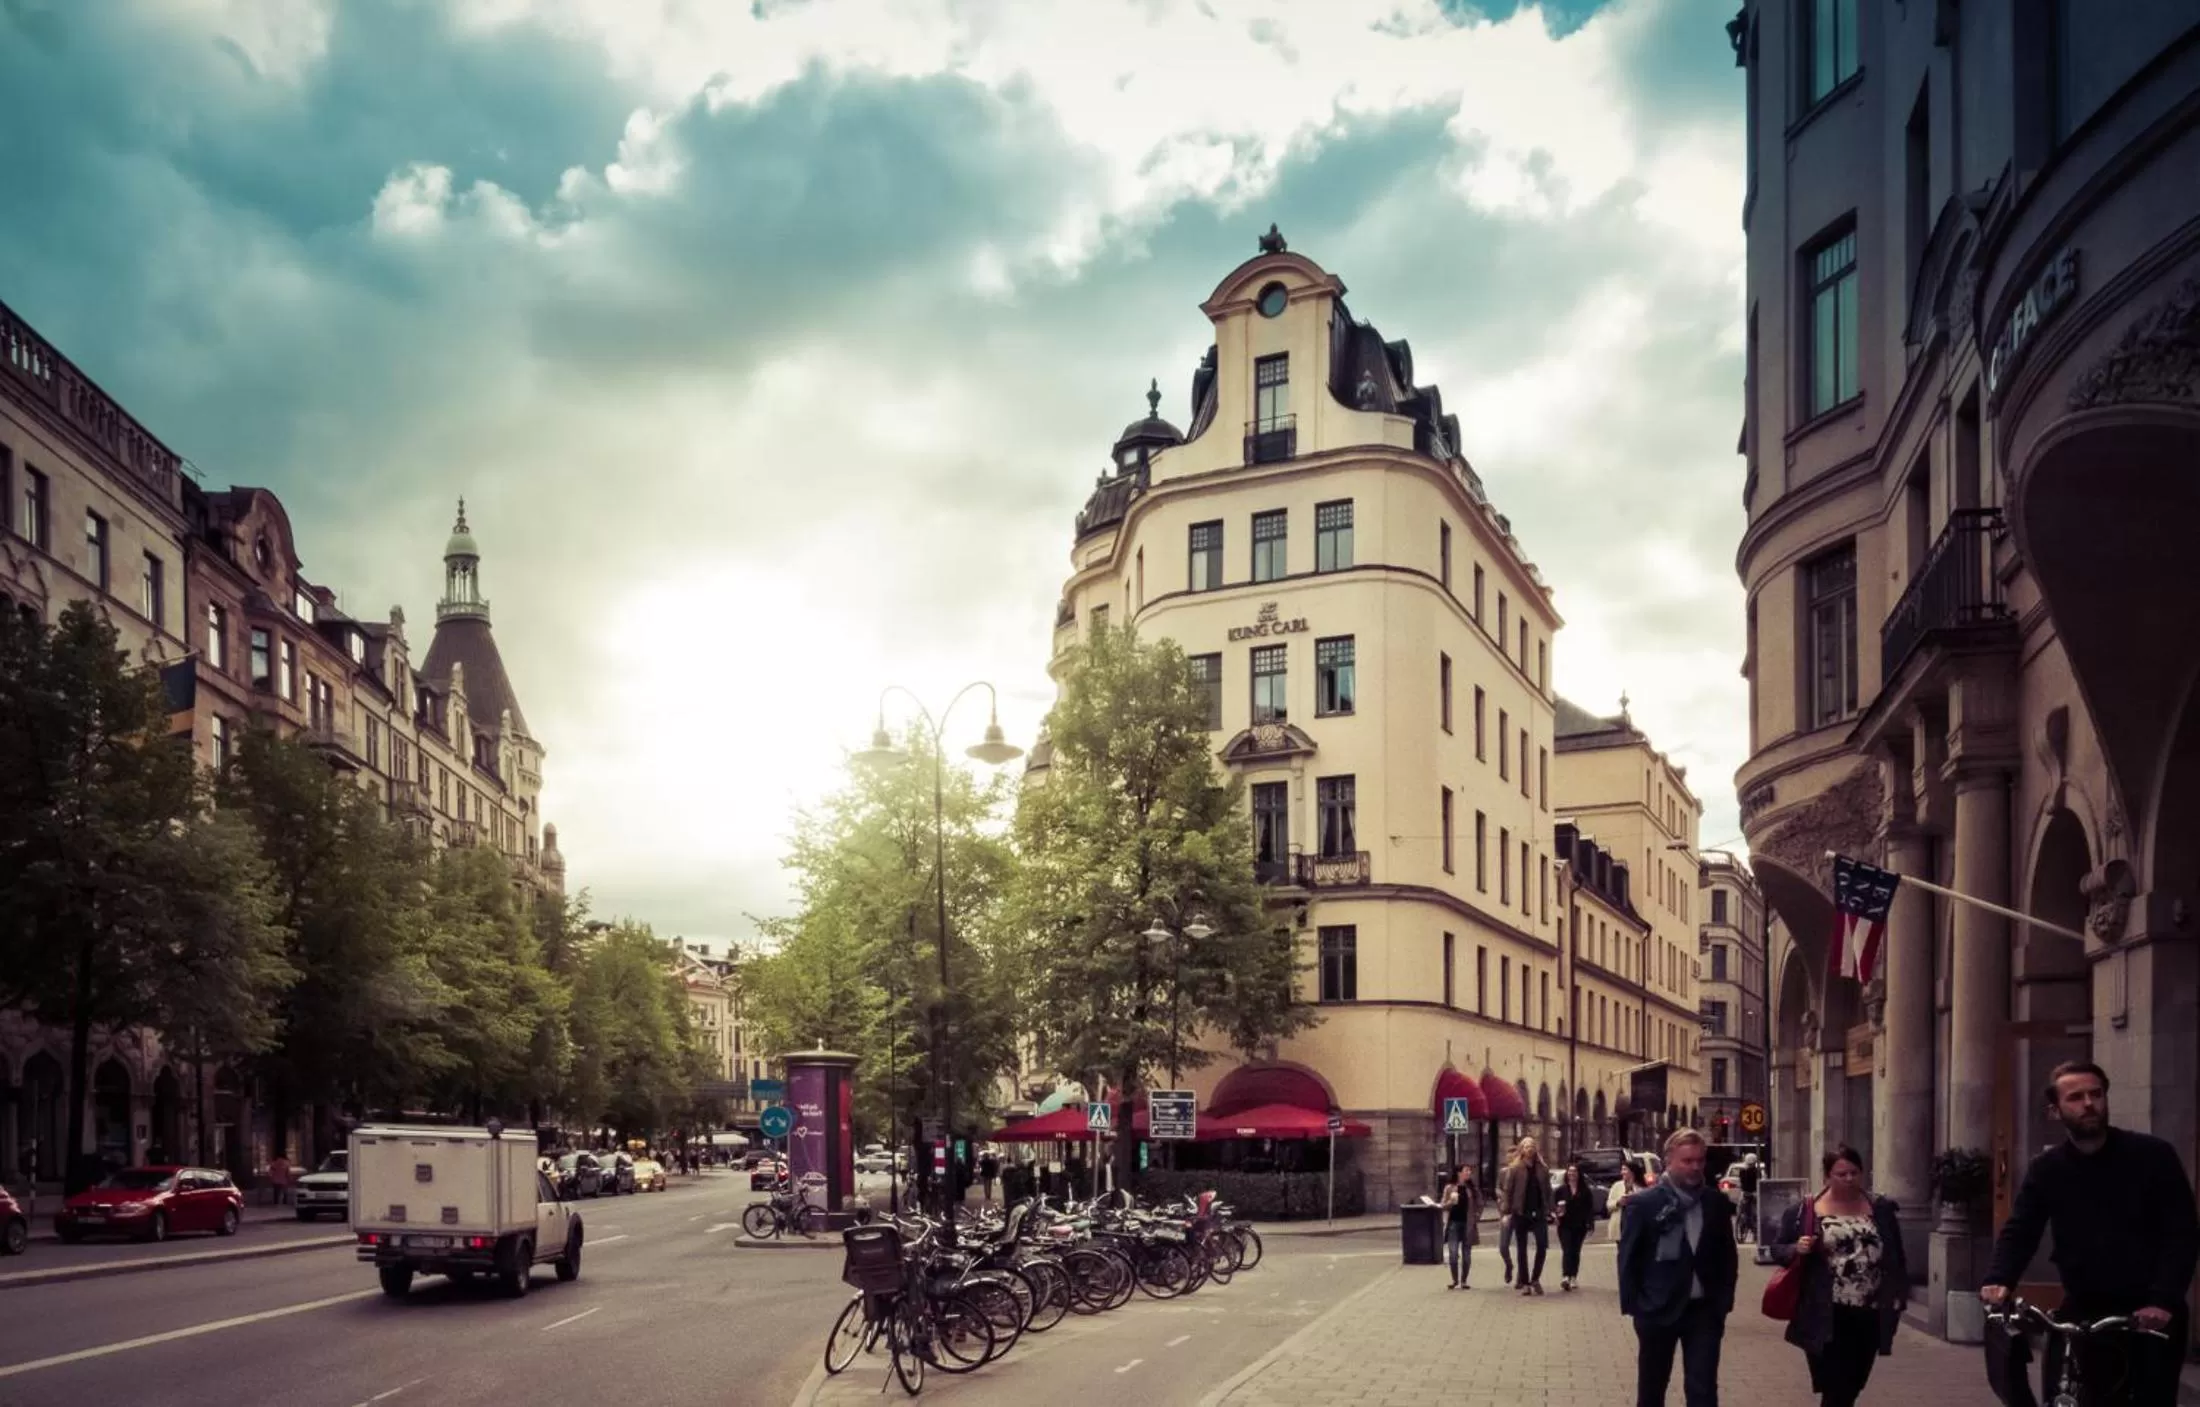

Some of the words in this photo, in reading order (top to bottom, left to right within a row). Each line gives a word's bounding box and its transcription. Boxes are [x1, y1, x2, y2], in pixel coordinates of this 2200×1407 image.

[1228, 624, 1268, 642] KUNG
[1272, 618, 1309, 635] CARL
[1744, 1110, 1763, 1125] 30
